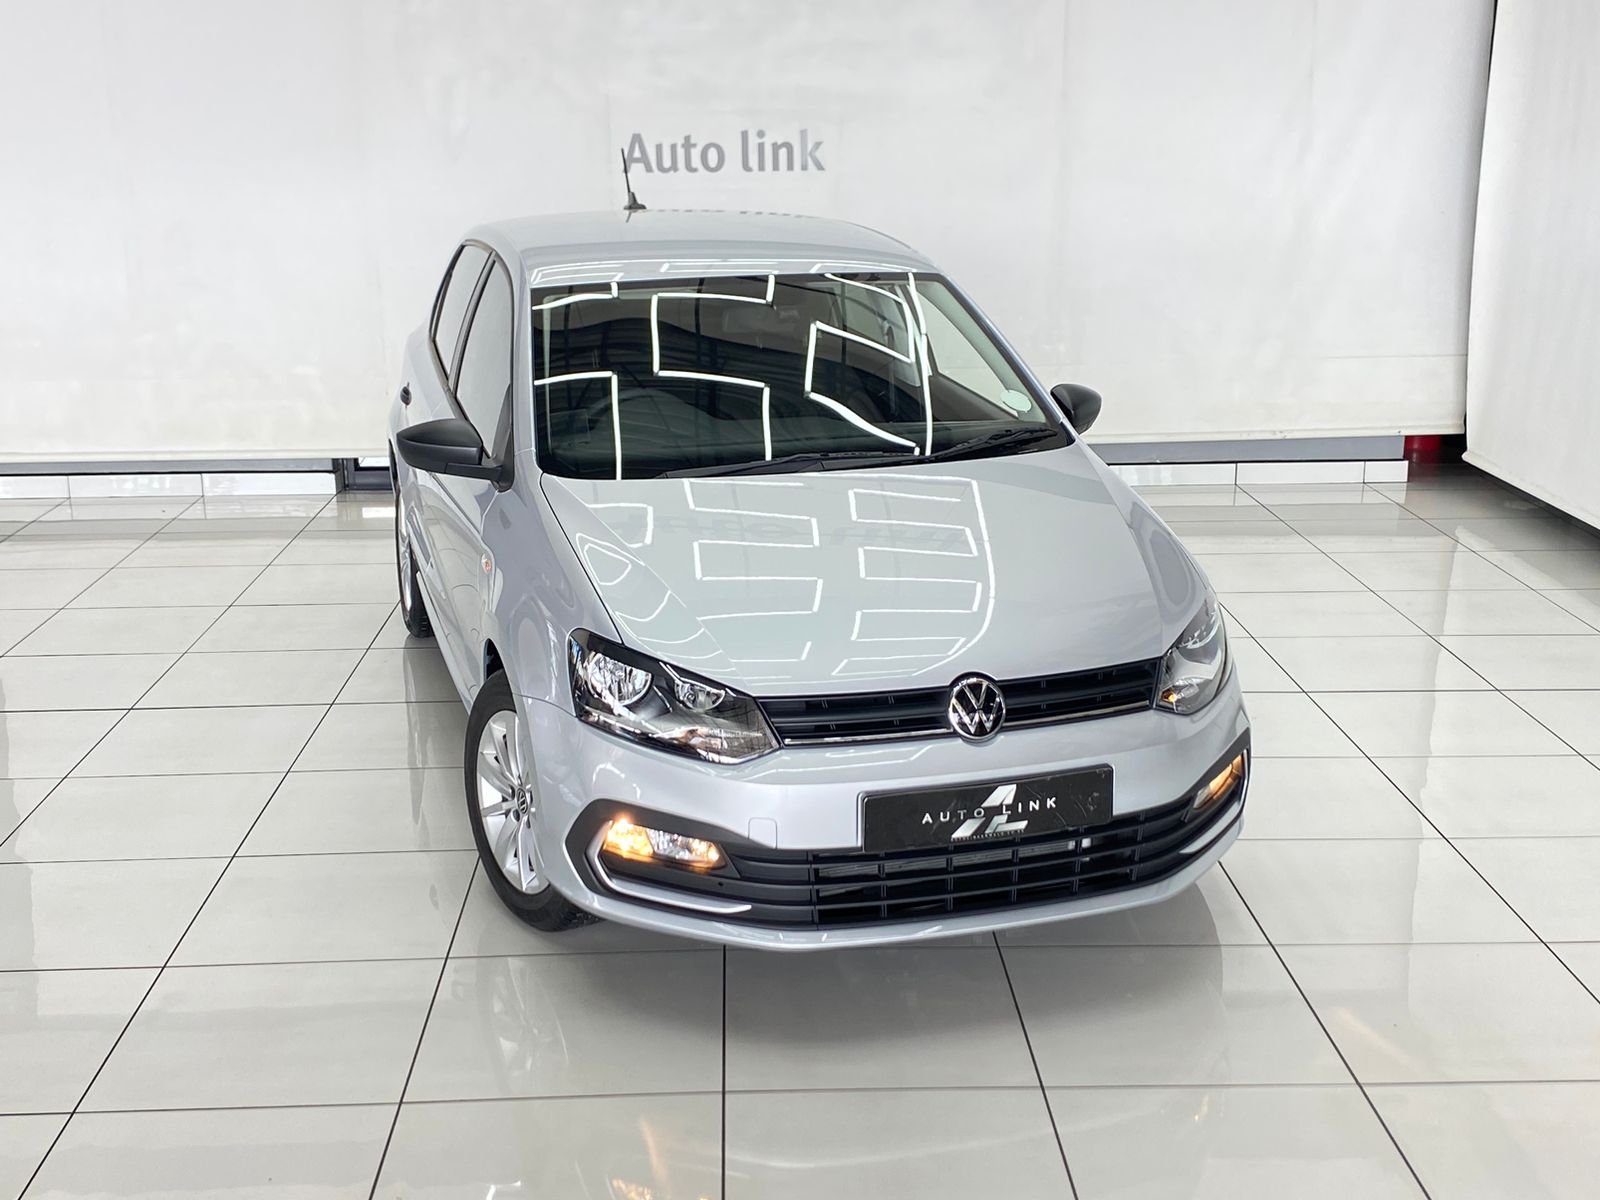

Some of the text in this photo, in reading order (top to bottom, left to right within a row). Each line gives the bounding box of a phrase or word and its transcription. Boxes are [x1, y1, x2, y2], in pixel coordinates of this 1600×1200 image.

[623, 129, 826, 173] Auto link
[921, 797, 1057, 824] AUTO LINK
